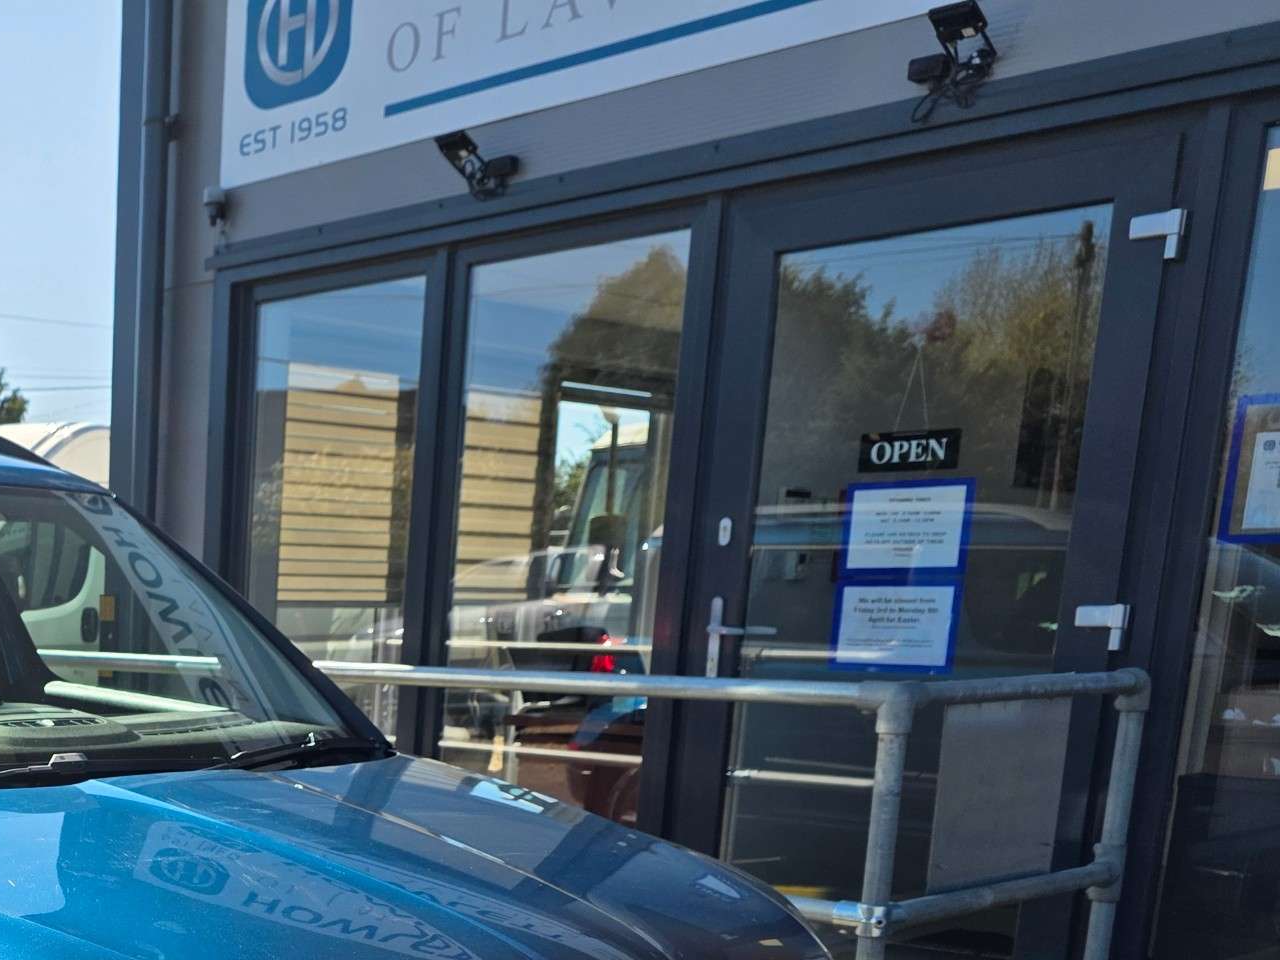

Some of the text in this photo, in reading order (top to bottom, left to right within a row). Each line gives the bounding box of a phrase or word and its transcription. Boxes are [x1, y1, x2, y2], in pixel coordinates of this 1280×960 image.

[387, 7, 462, 73] OF
[239, 107, 349, 157] EST 1958
[870, 437, 949, 465] OPEN
